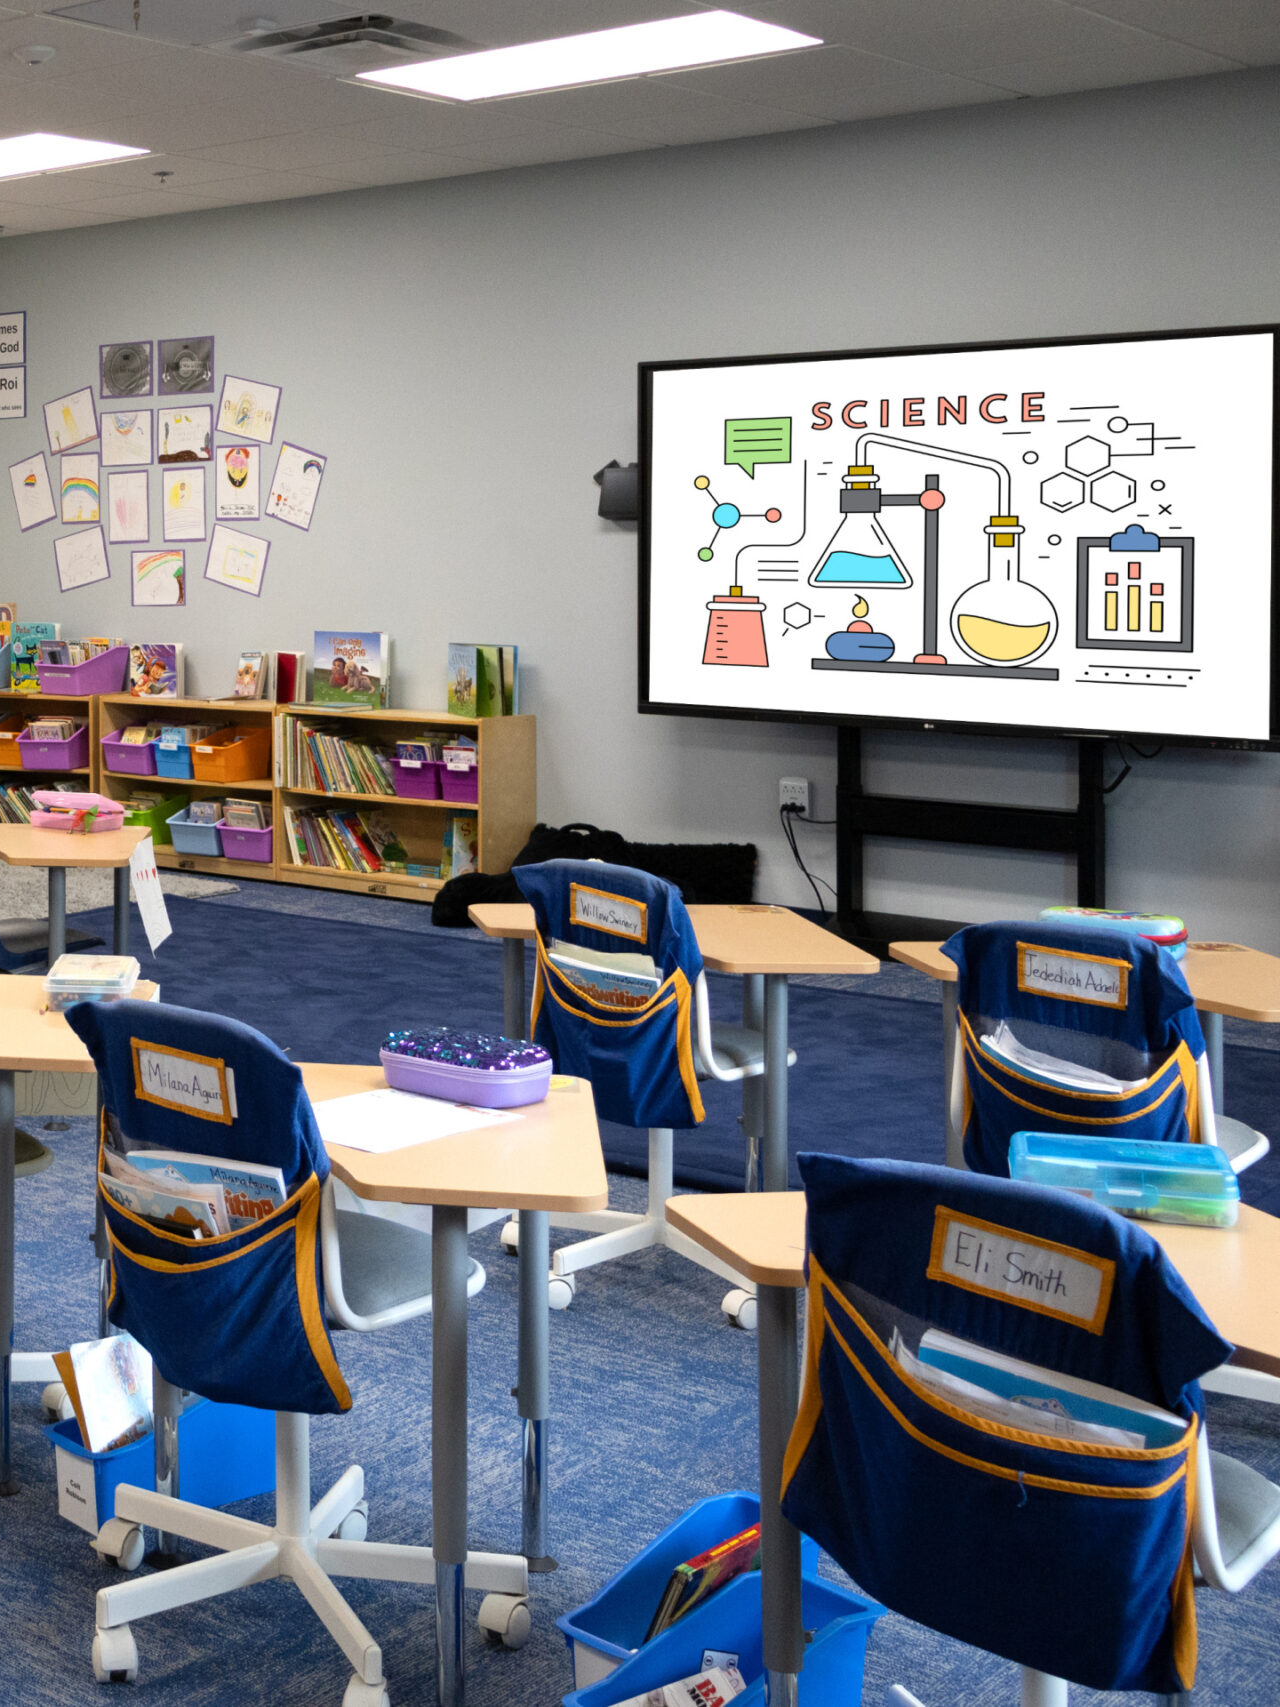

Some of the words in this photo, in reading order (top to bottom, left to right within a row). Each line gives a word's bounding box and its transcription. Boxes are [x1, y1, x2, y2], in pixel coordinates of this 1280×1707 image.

[0, 341, 20, 354] God
[0, 377, 18, 391] Roi
[811, 391, 1046, 431] SCIENCE
[35, 625, 48, 635] Cat
[581, 897, 609, 923] Willow
[1024, 952, 1082, 987] Jedediah
[147, 1058, 191, 1095] Milana
[209, 1167, 246, 1185] Milana
[224, 1188, 275, 1222] riting
[955, 1230, 993, 1274] Eli
[1002, 1251, 1067, 1297] Smith
